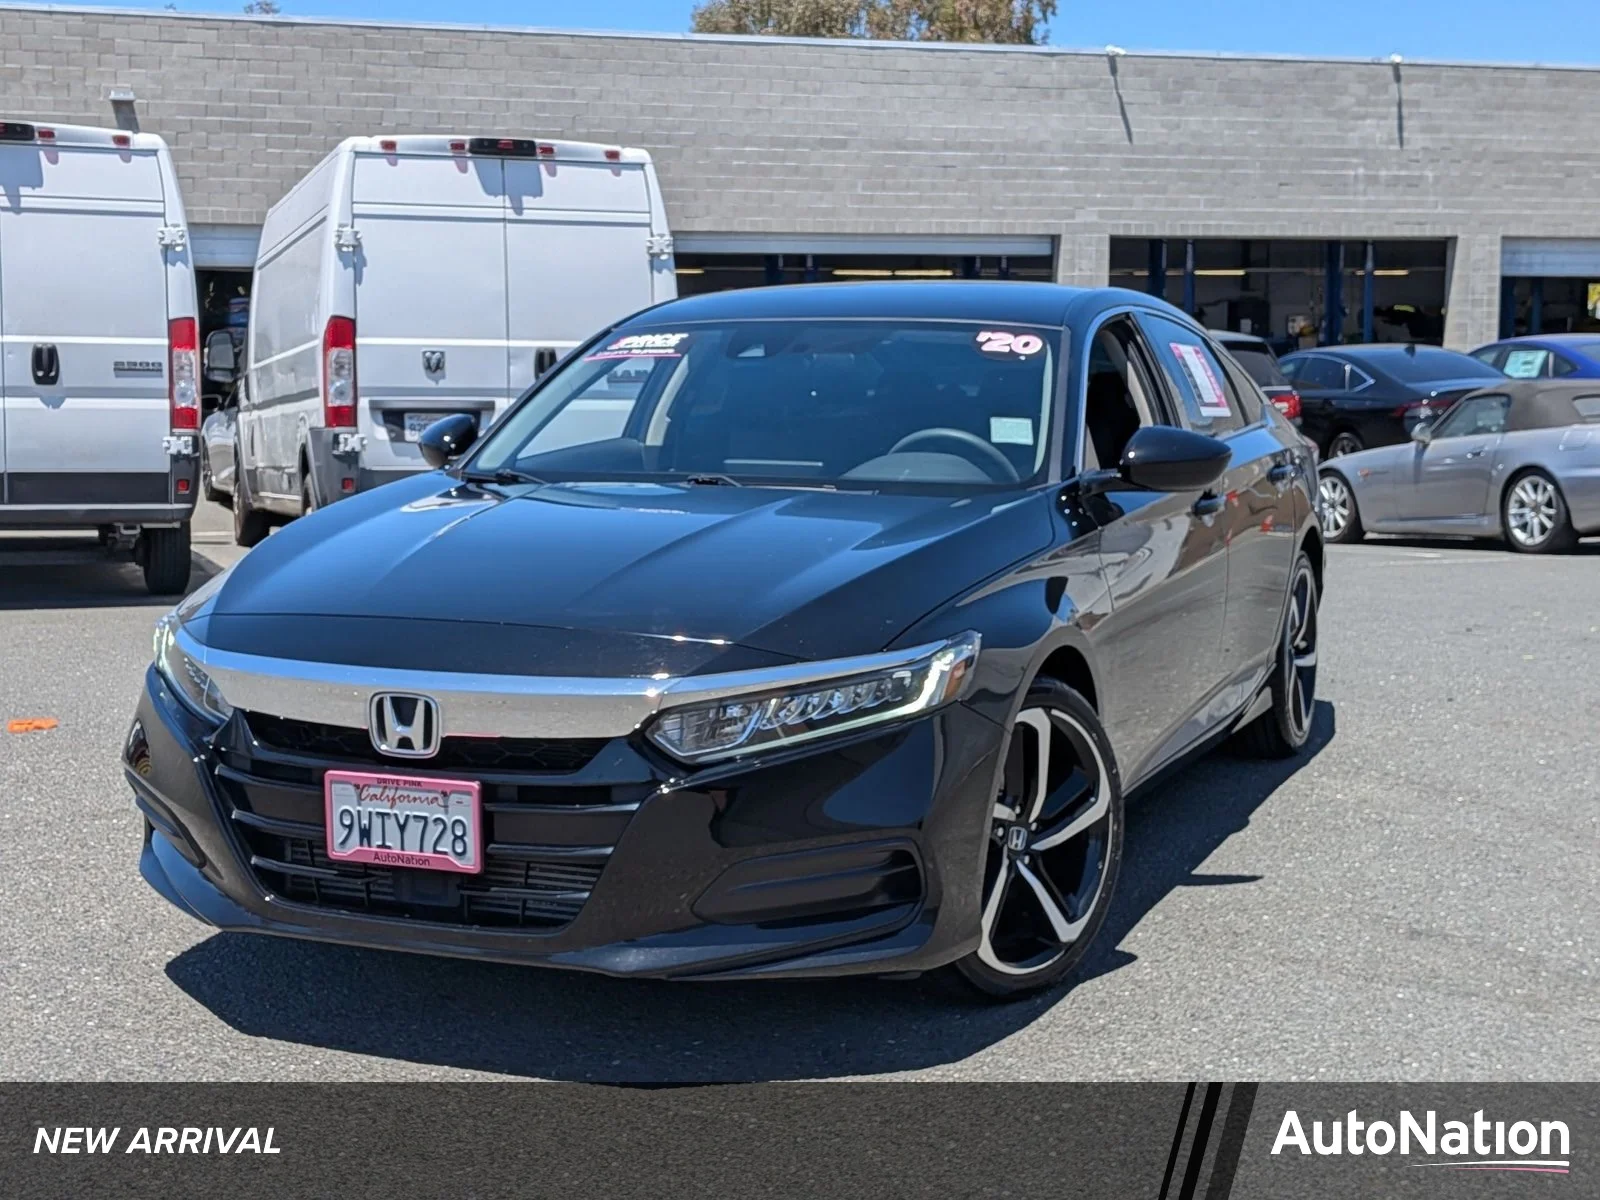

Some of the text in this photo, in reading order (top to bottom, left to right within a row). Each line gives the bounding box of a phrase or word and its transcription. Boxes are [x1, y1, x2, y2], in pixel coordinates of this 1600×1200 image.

[376, 778, 401, 786] DRIVE
[359, 784, 449, 809] California
[339, 808, 468, 857] 9WIY728
[373, 852, 430, 867] AutoNation
